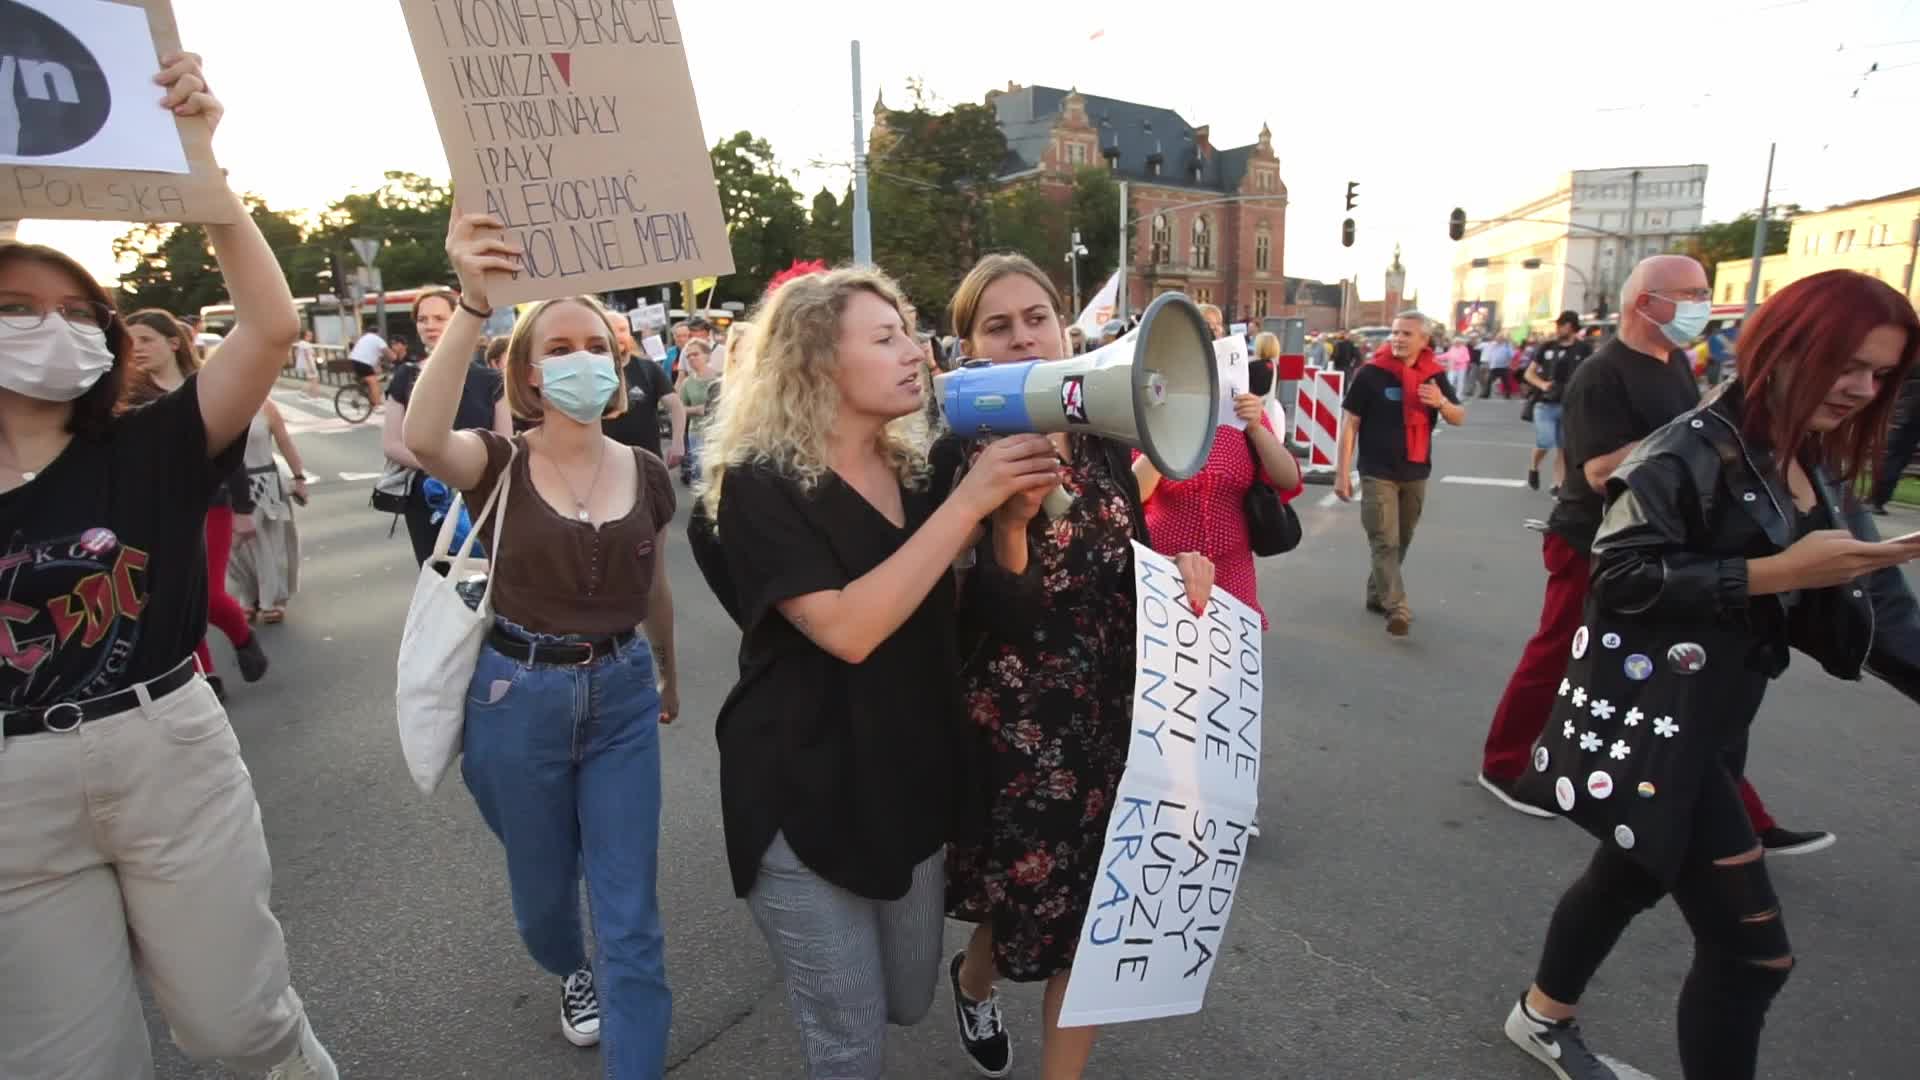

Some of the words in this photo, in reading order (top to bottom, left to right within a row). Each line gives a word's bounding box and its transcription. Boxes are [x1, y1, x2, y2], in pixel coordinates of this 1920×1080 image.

[13, 166, 187, 215] POLSKA
[486, 143, 554, 183] PAŁY
[633, 211, 704, 266] MEDIA
[1137, 560, 1168, 756] WOLNY
[1205, 597, 1232, 763] WOLNE
[1235, 616, 1260, 780] WOLNE
[1090, 797, 1151, 945] KRAJ
[1115, 800, 1186, 981] LUDZIE
[1183, 820, 1247, 979] MEDIA
